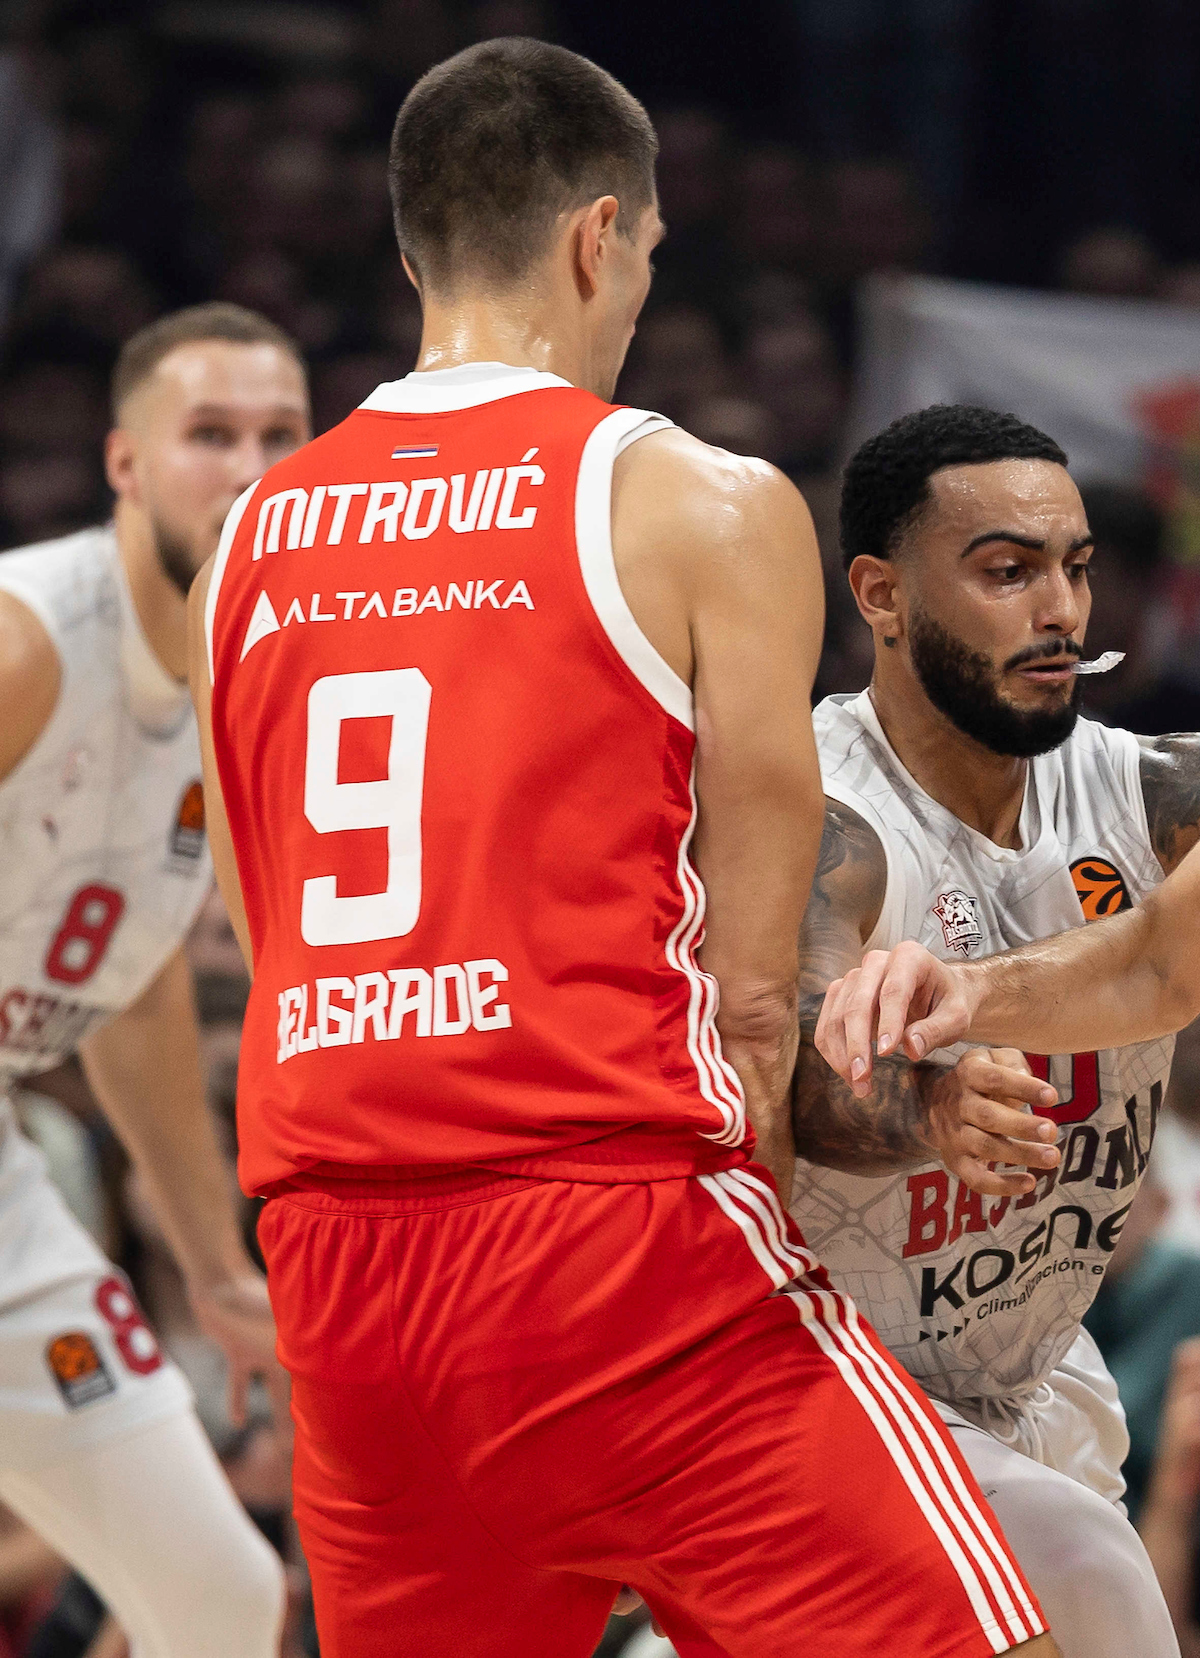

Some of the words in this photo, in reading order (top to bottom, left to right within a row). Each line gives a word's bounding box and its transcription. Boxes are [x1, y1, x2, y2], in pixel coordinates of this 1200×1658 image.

[252, 447, 546, 561] MITROVIĆ
[282, 579, 535, 627] ALTABANKA
[300, 667, 433, 947] 9
[44, 880, 126, 986] 8
